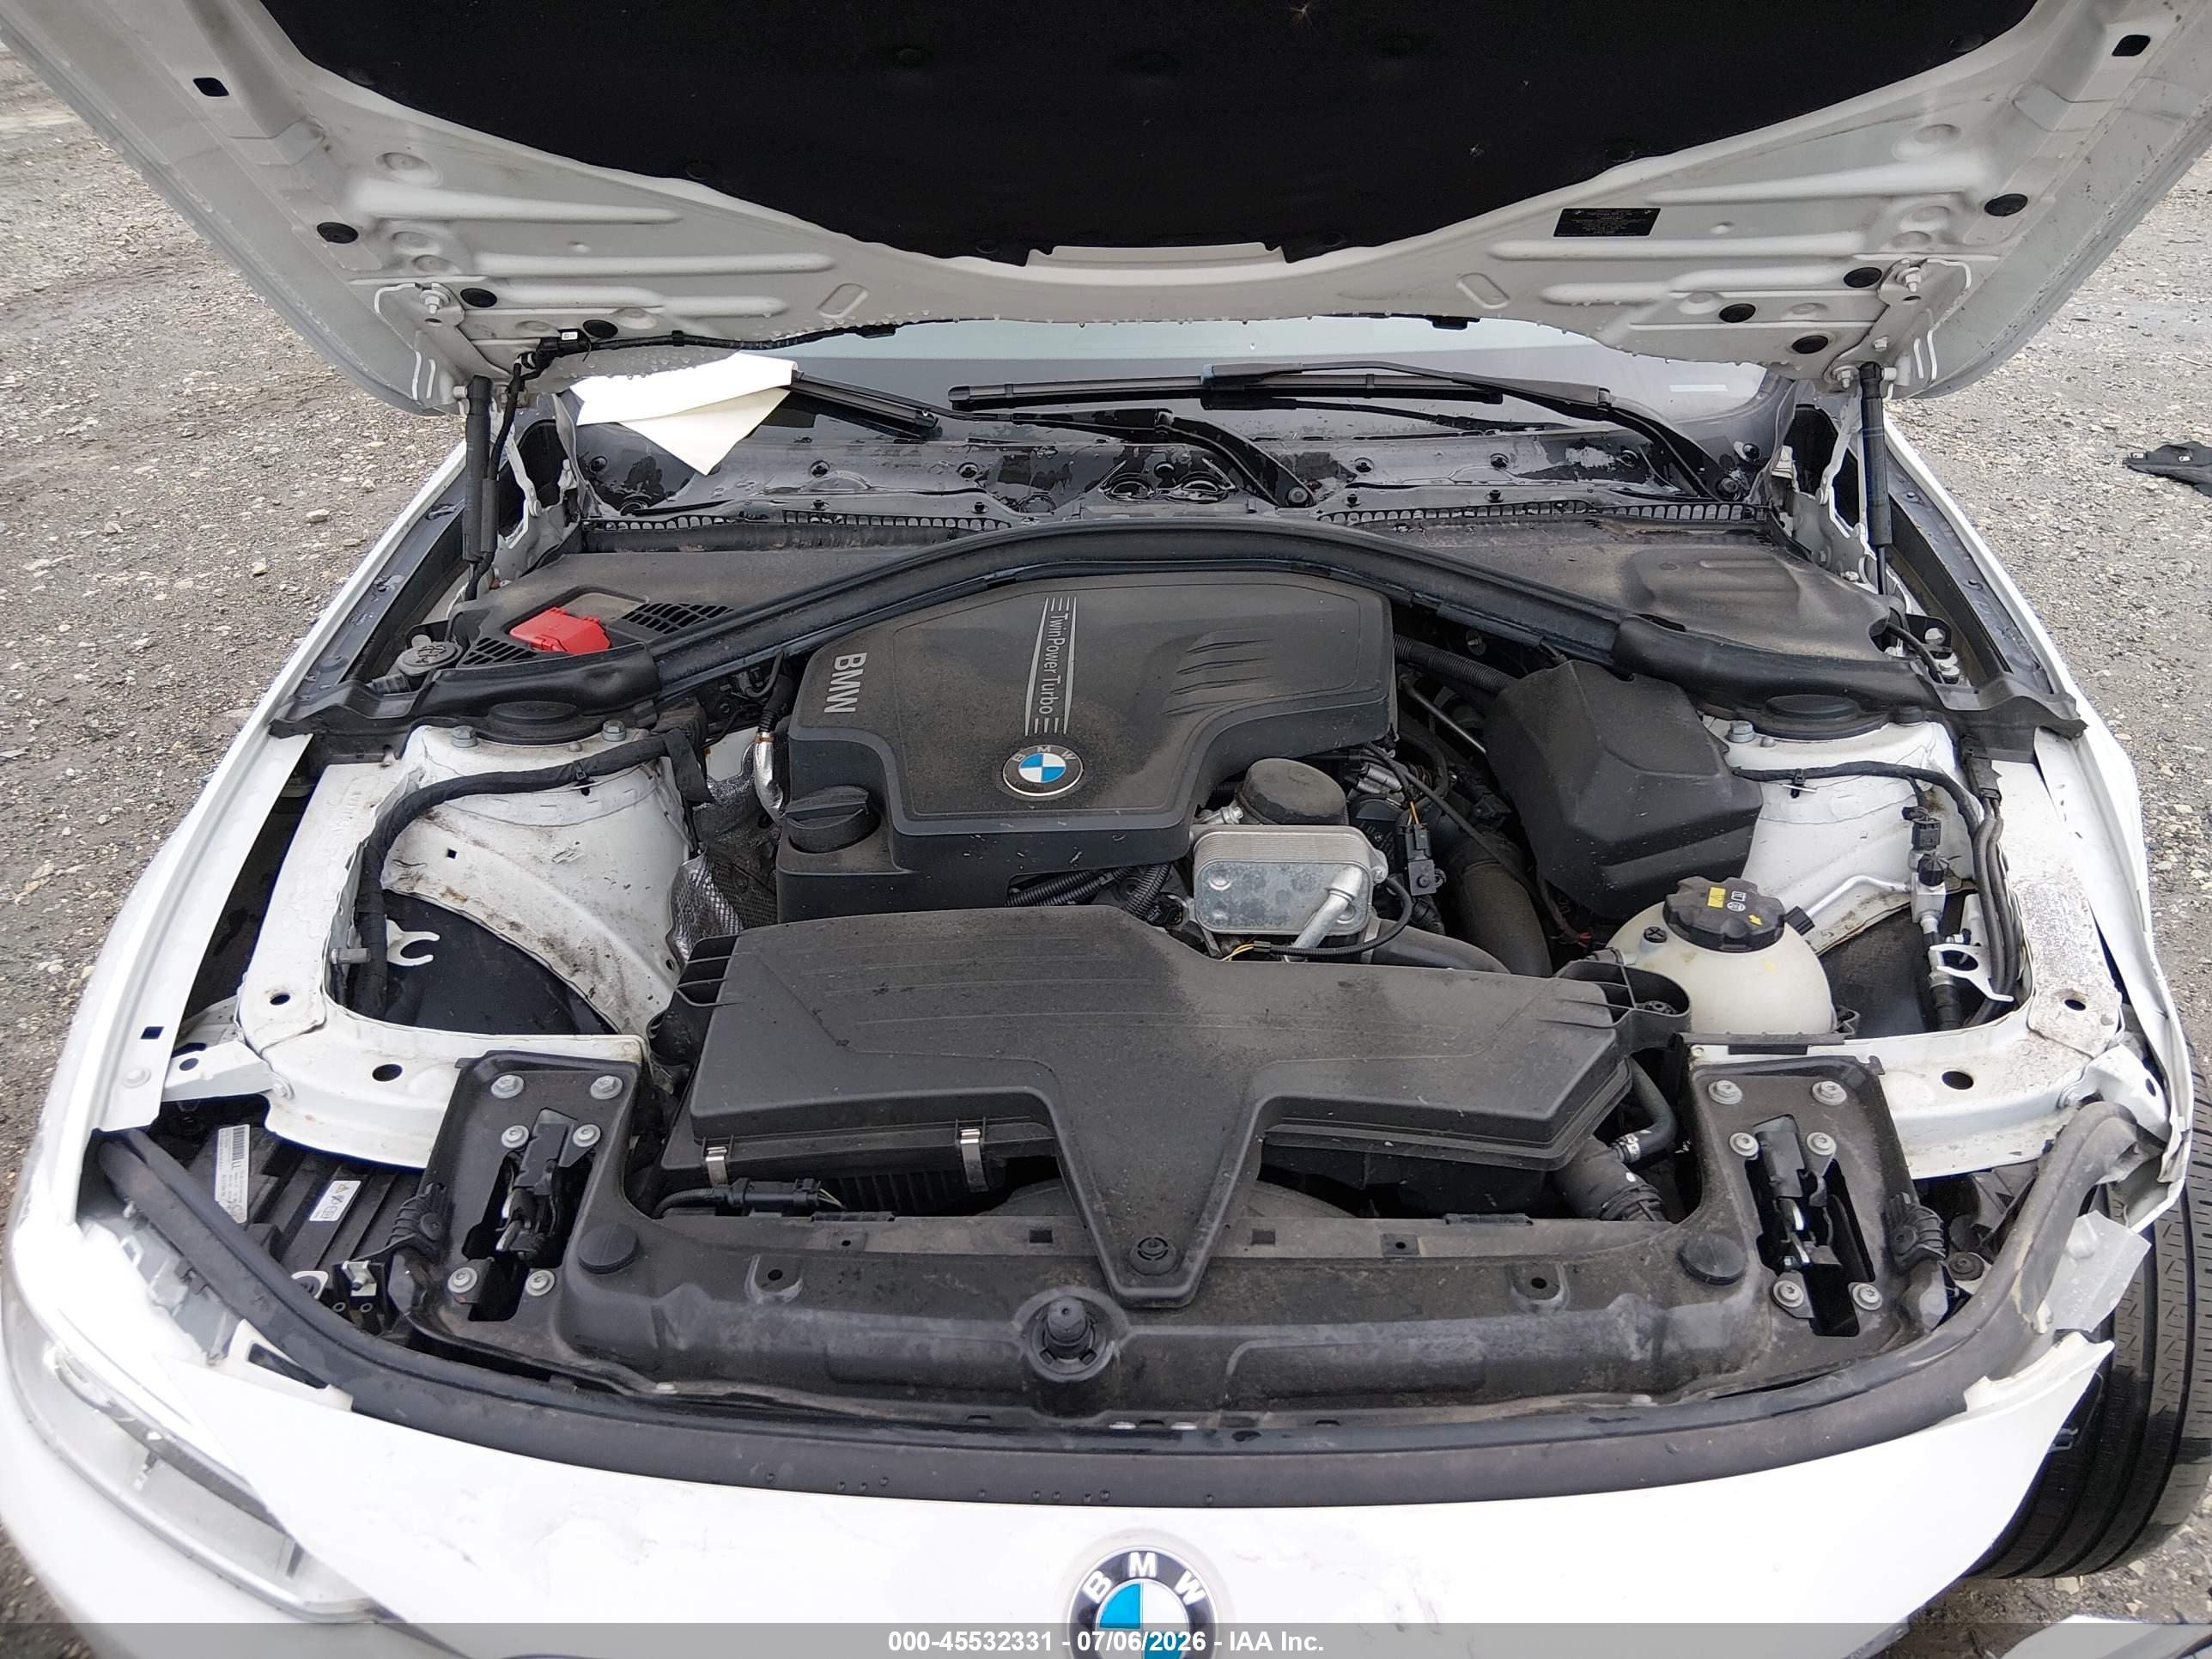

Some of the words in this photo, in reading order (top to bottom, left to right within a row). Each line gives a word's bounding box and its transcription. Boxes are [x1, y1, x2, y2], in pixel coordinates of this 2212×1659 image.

[1043, 612, 1068, 674] TwinPower
[823, 651, 867, 714] BMW
[1038, 675, 1061, 714] Turbo
[1010, 745, 1077, 763] BMW
[1082, 1551, 1206, 1606] BMW
